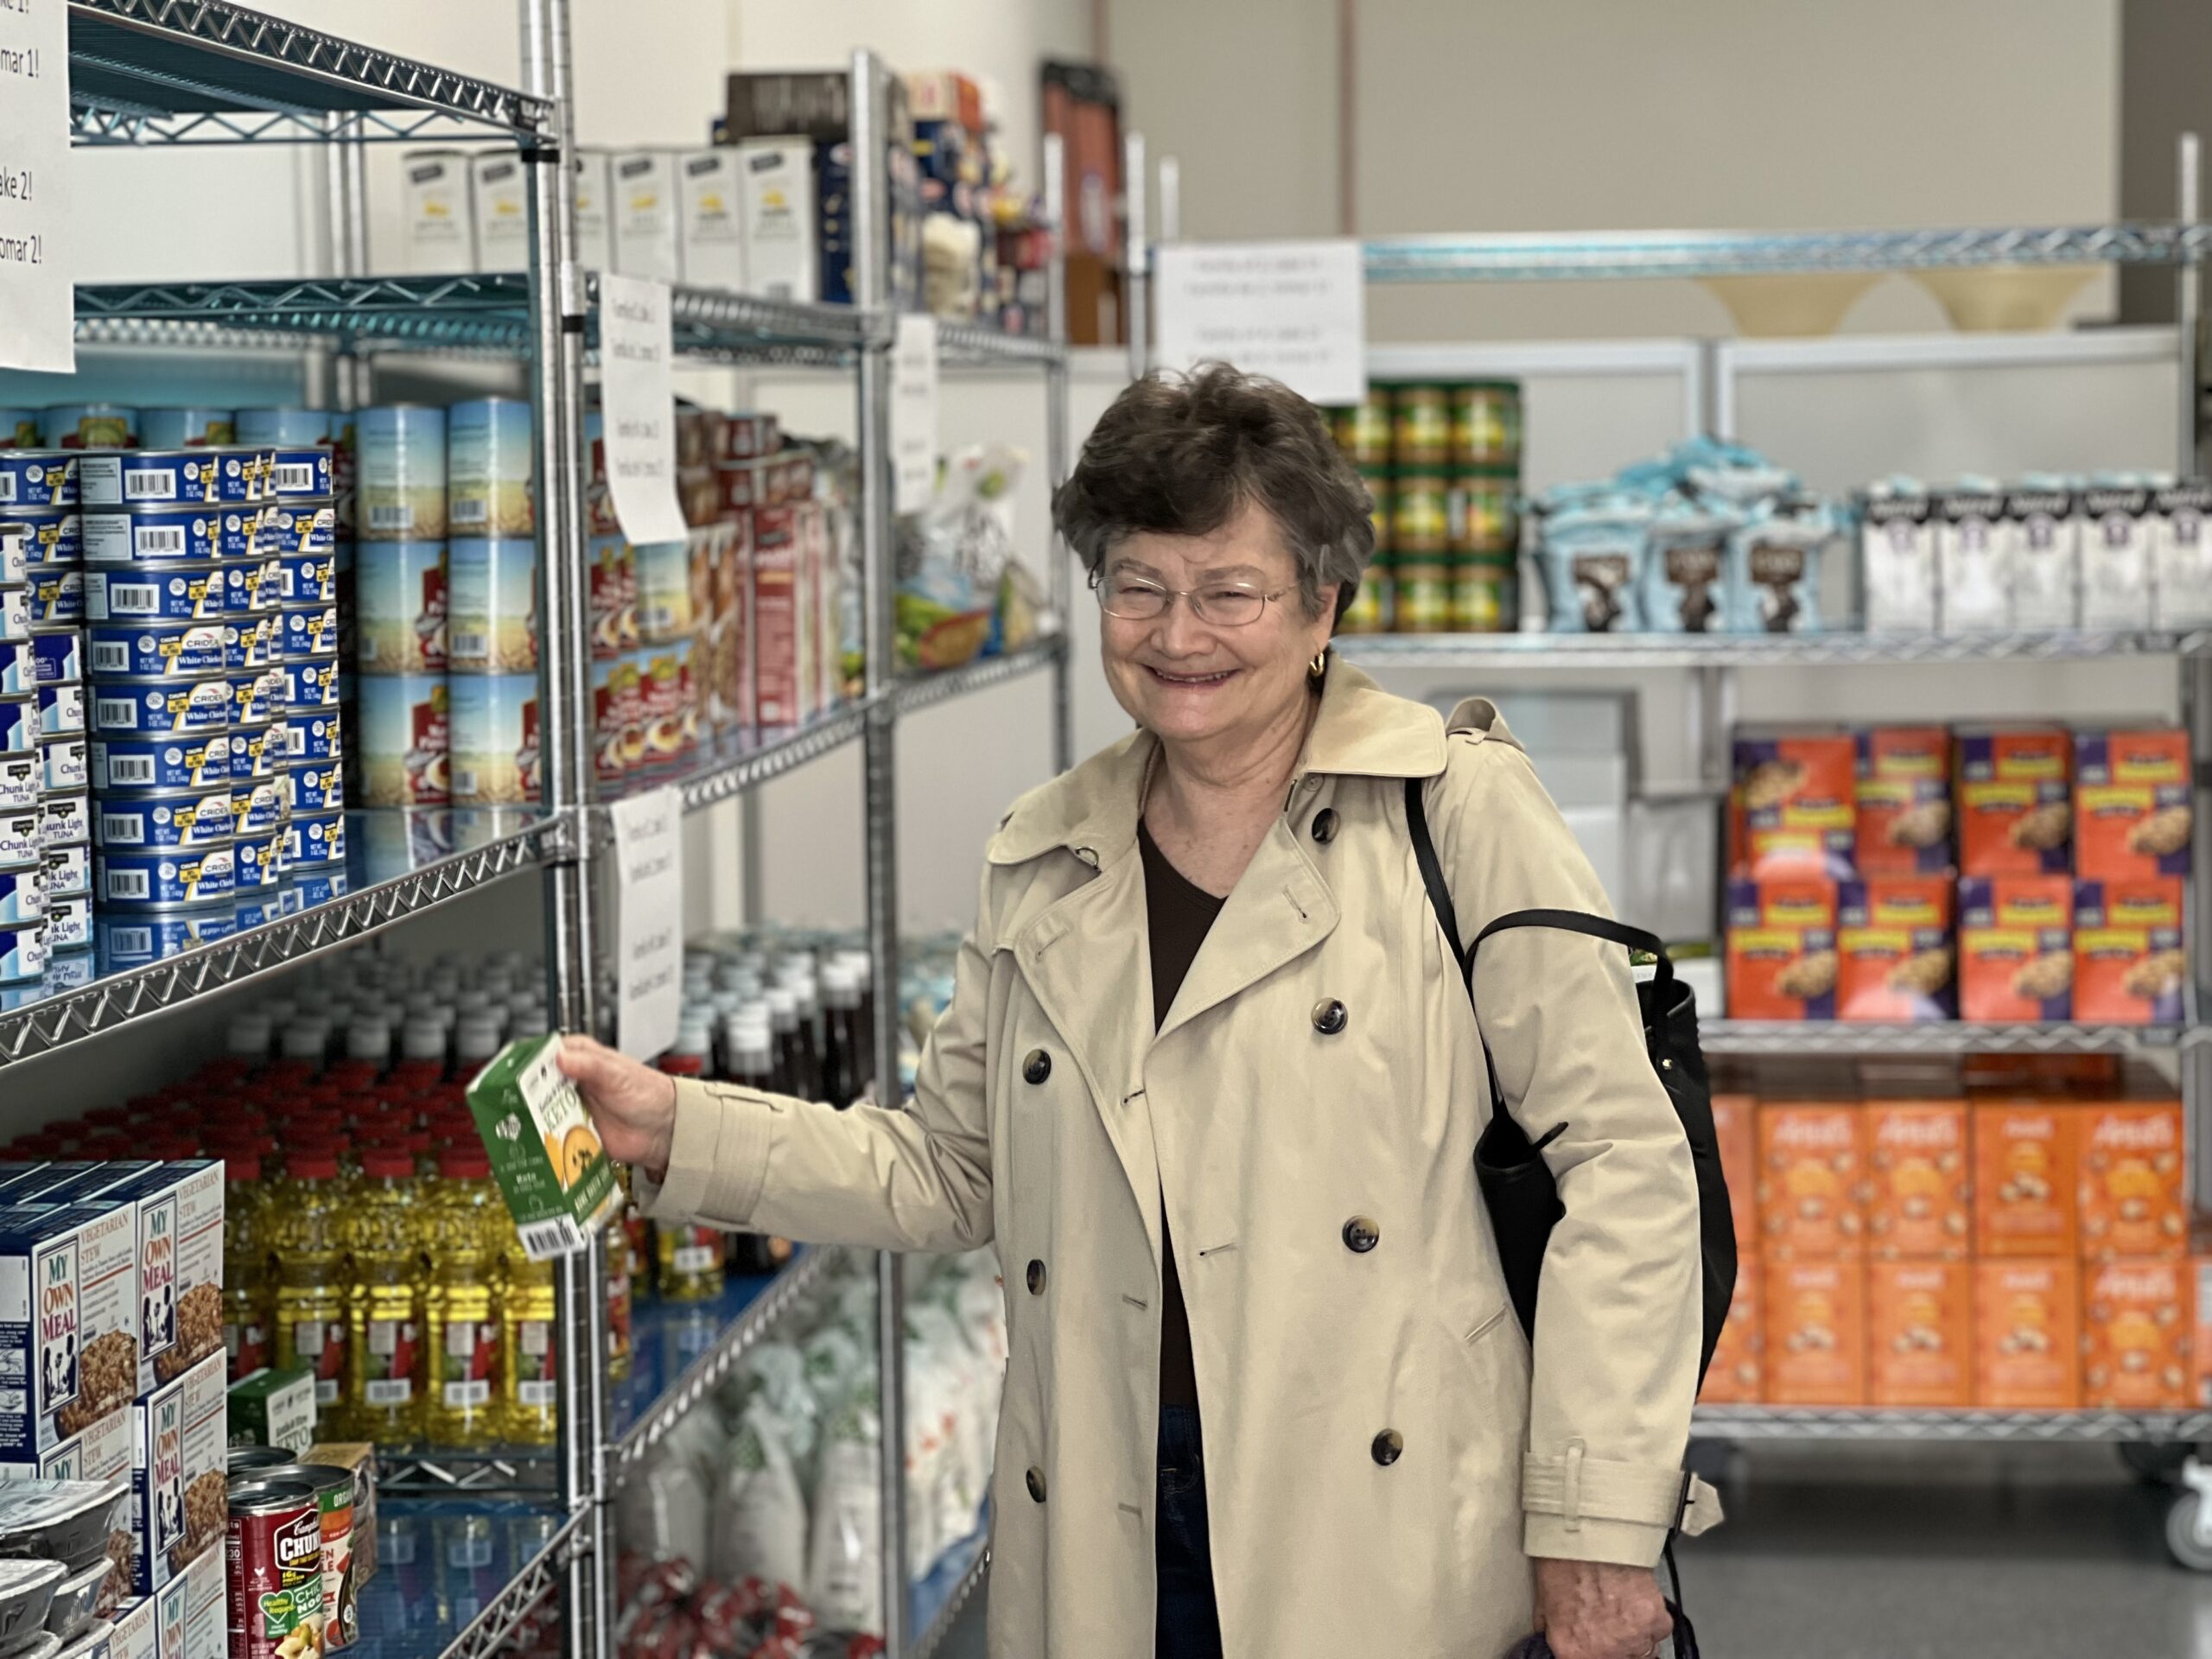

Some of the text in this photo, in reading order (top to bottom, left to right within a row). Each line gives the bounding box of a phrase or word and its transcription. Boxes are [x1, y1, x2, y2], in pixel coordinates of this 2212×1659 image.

[28, 48, 39, 79] 1!
[21, 171, 32, 201] 2!
[30, 234, 41, 264] 2!
[186, 711, 208, 721] White
[67, 818, 83, 830] Light
[193, 825, 214, 835] White
[0, 839, 28, 850] Chunk
[59, 869, 78, 882] Light
[61, 921, 80, 934] Light
[544, 1085, 577, 1131] KETO
[179, 1170, 219, 1200] VEGETARIAN
[150, 1210, 168, 1238] MY
[179, 1201, 195, 1219] STEW
[80, 1211, 129, 1243] VEGETARIAN
[80, 1244, 102, 1266] STEW
[145, 1235, 171, 1266] OWN
[48, 1255, 67, 1285] MY
[143, 1262, 174, 1294] MEAL
[44, 1281, 74, 1314] OWN
[43, 1309, 77, 1344] MEAL
[162, 1402, 176, 1432] MY
[156, 1427, 178, 1459] OWN
[156, 1452, 180, 1488] MEAL
[167, 1595, 180, 1626] MY
[263, 1598, 289, 1606] Healthy
[114, 1643, 130, 1659] TEW
[165, 1618, 182, 1656] OWN
